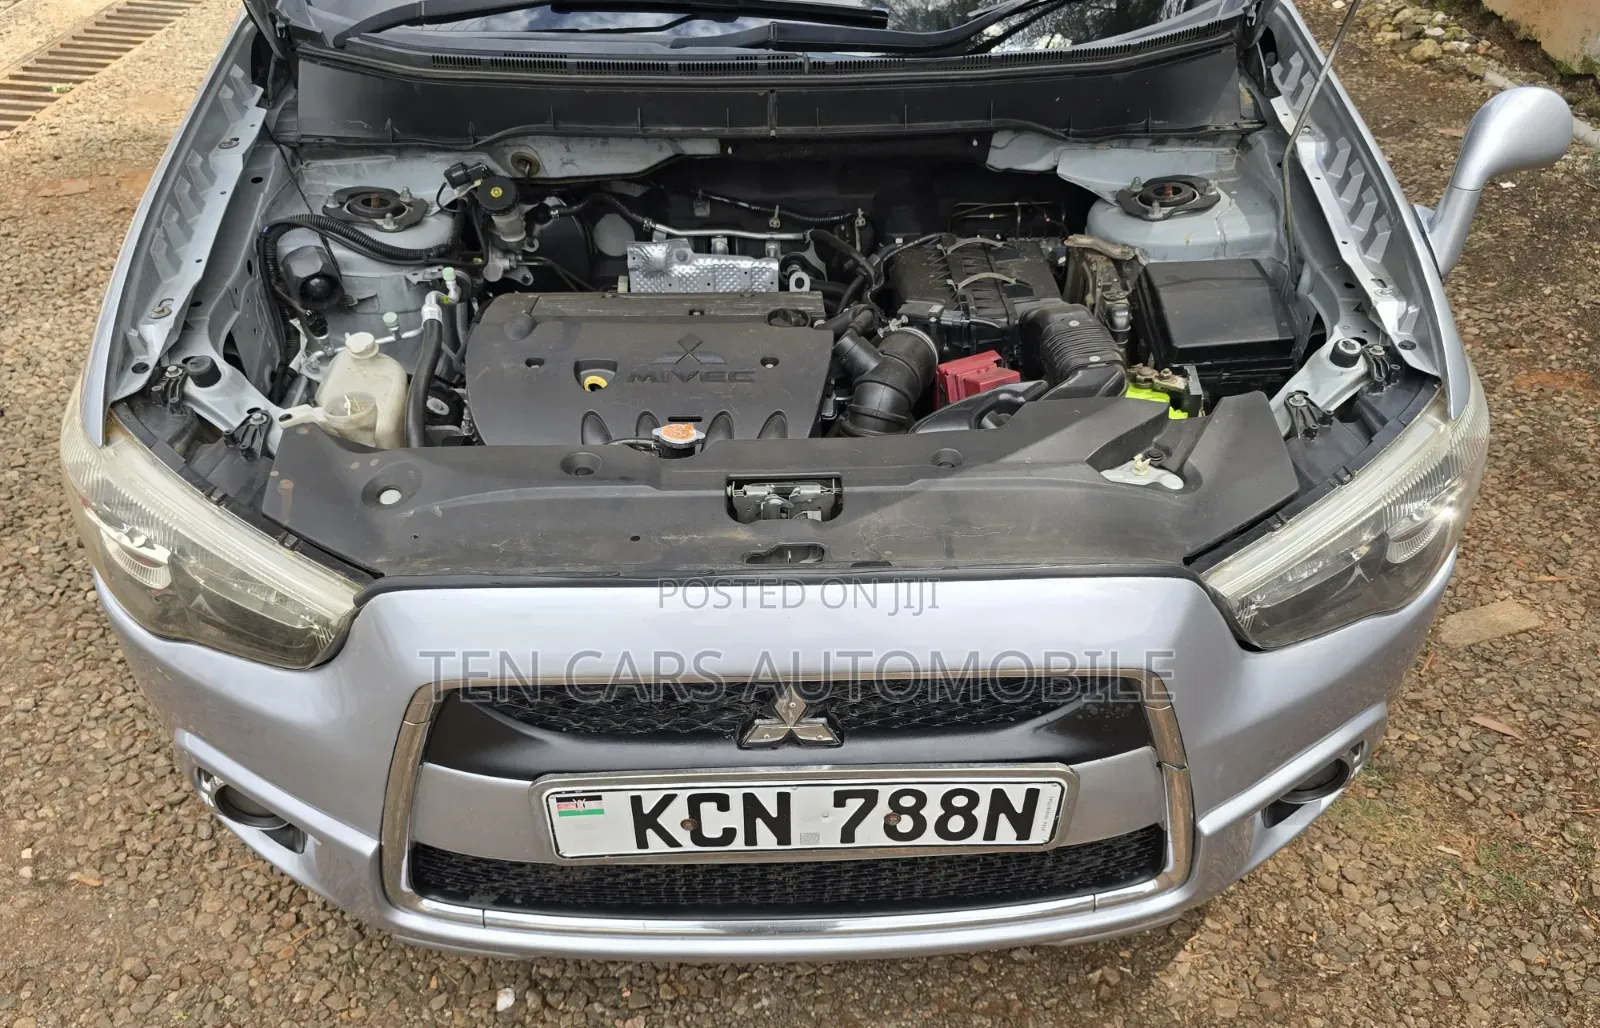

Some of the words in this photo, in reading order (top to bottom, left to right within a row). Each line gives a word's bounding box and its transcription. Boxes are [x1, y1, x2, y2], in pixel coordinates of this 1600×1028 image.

[627, 369, 756, 384] MIVEC
[630, 790, 793, 850] KCN
[833, 787, 1042, 844] 788N
